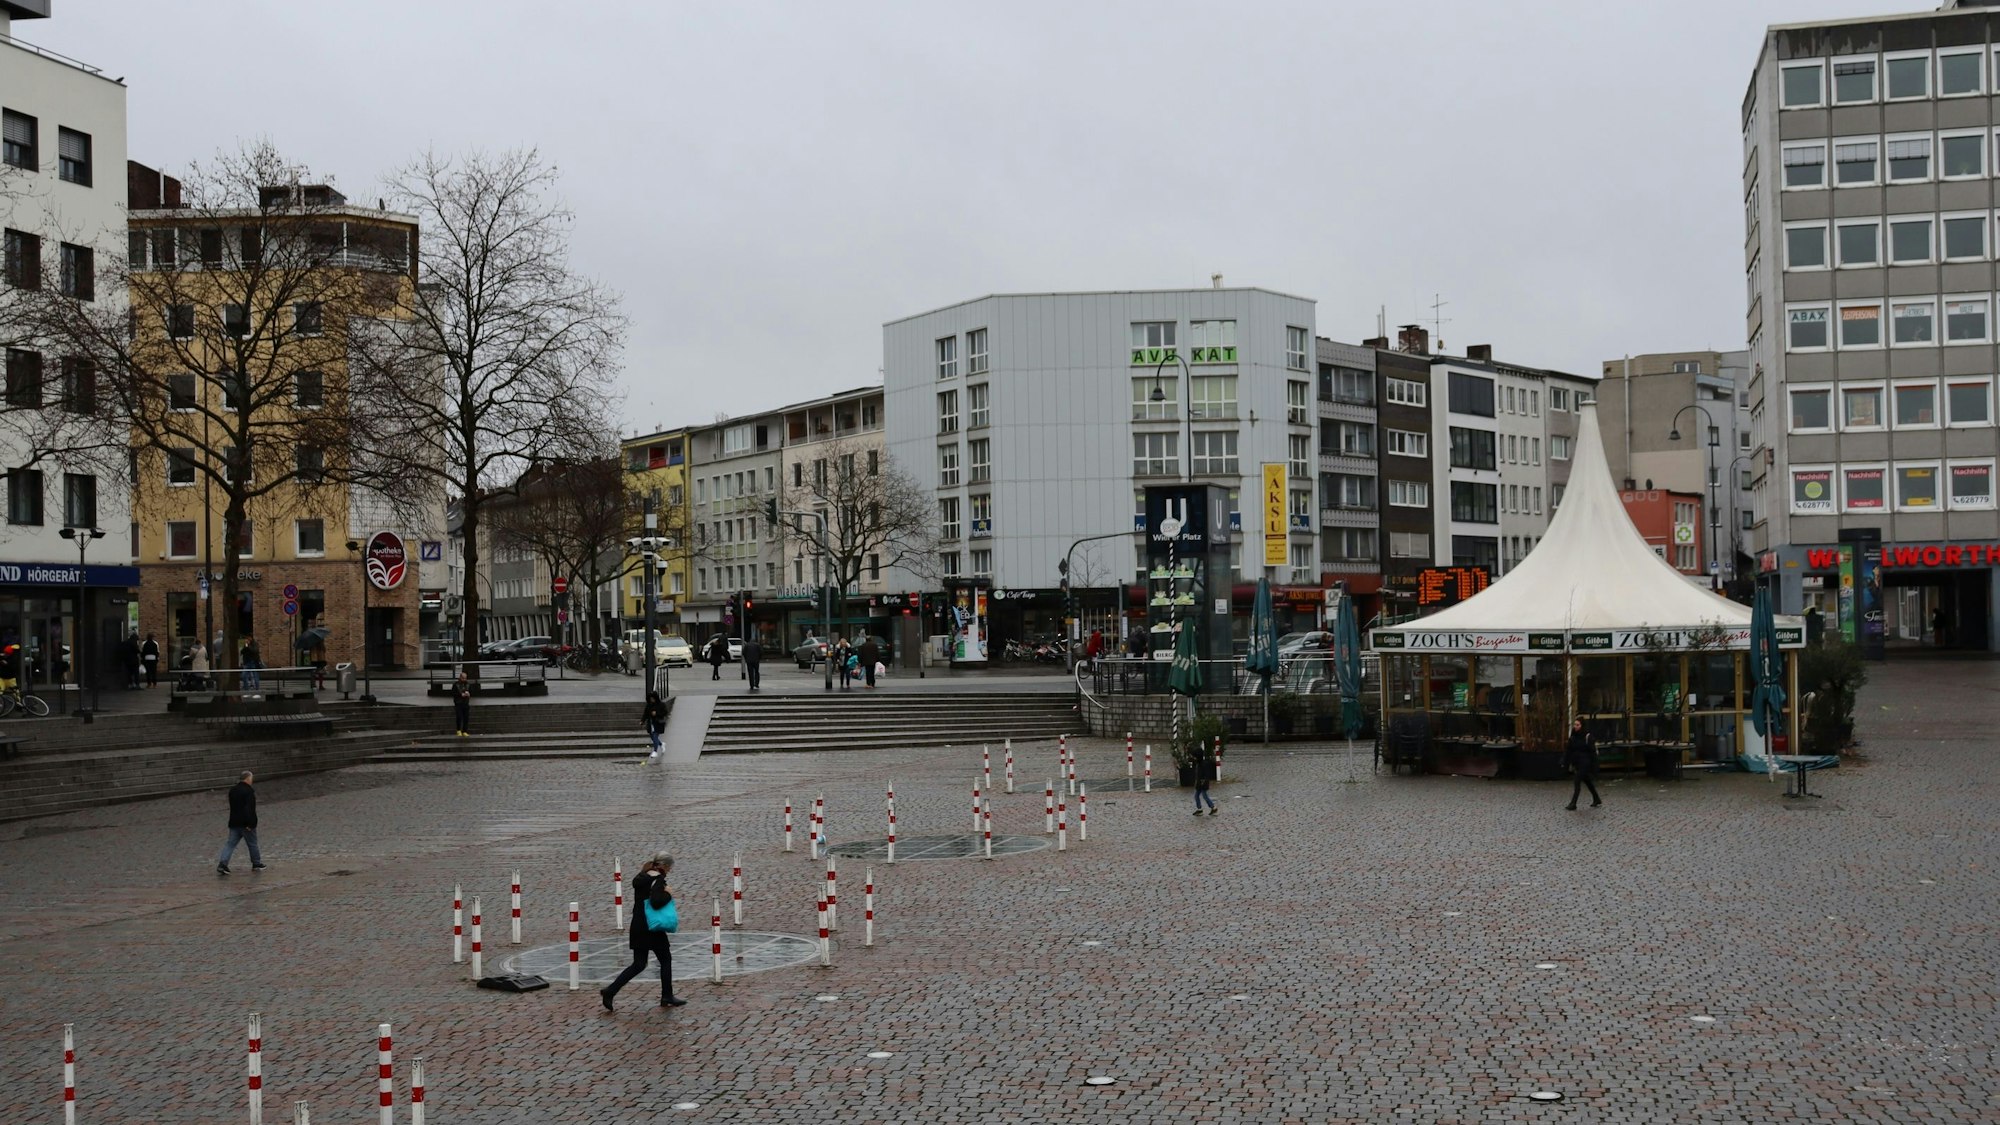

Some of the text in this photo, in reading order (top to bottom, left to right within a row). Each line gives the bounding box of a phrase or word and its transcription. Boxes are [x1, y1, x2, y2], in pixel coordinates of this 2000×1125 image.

[1792, 312, 1825, 321] ABAX
[1269, 478, 1281, 532] AKSU
[1166, 498, 1187, 528] U
[1808, 545, 2000, 569] WLWORTH
[196, 568, 261, 581] Aoeke
[1410, 634, 1524, 650] ZOCH'S Biergarten
[1540, 637, 1561, 645] Gilden
[1585, 636, 1608, 645] Gilden
[1776, 631, 1798, 640] Gilden
